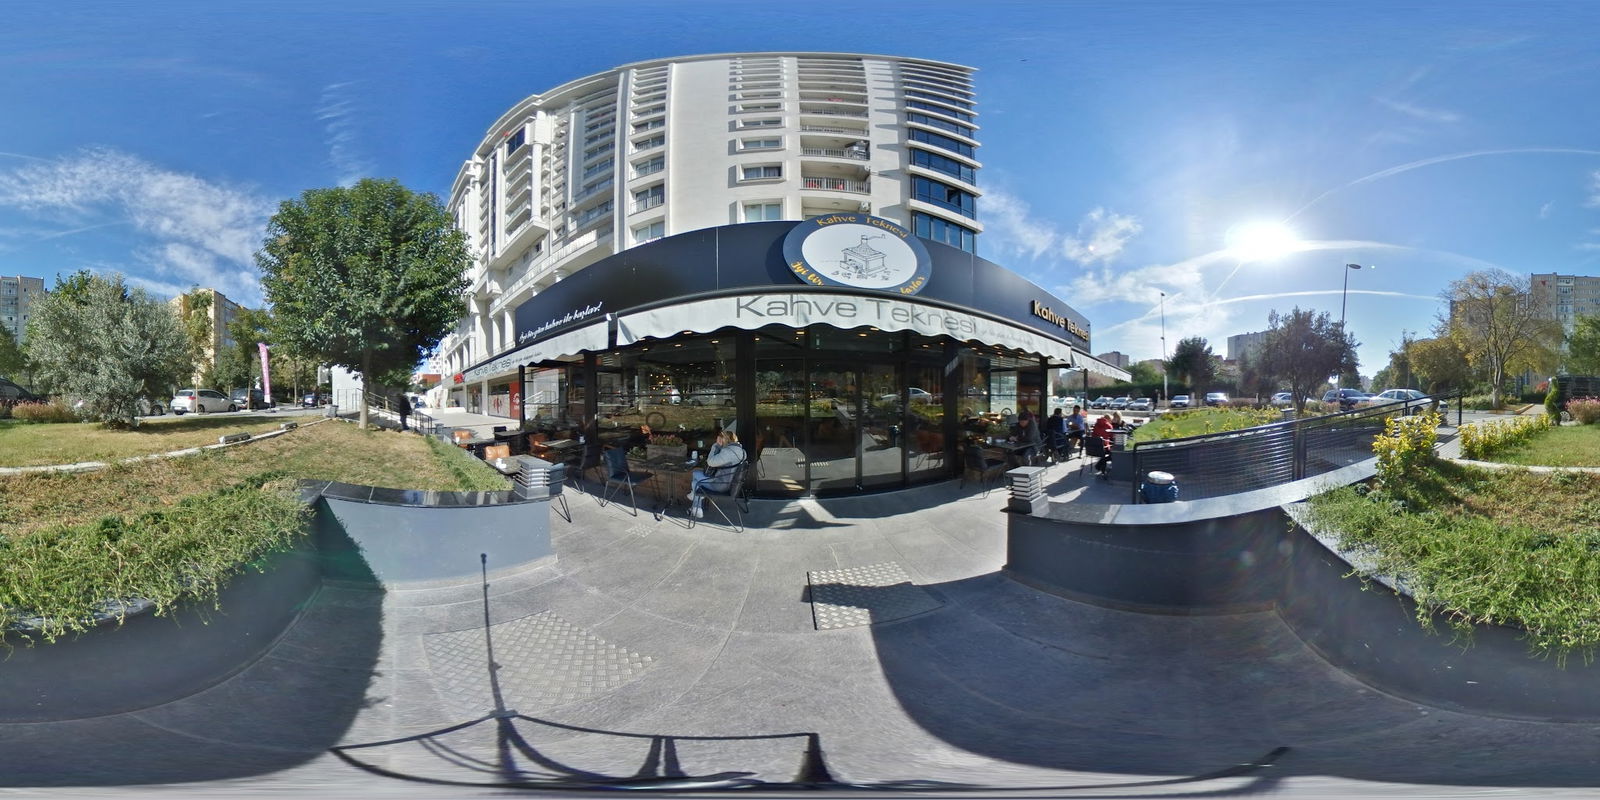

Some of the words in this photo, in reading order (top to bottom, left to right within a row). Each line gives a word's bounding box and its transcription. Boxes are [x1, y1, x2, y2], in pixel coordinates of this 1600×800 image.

[816, 215, 857, 226] Kahve
[736, 295, 858, 319] Kahve
[866, 299, 977, 335] Teknesi
[1033, 300, 1066, 328] Kahve
